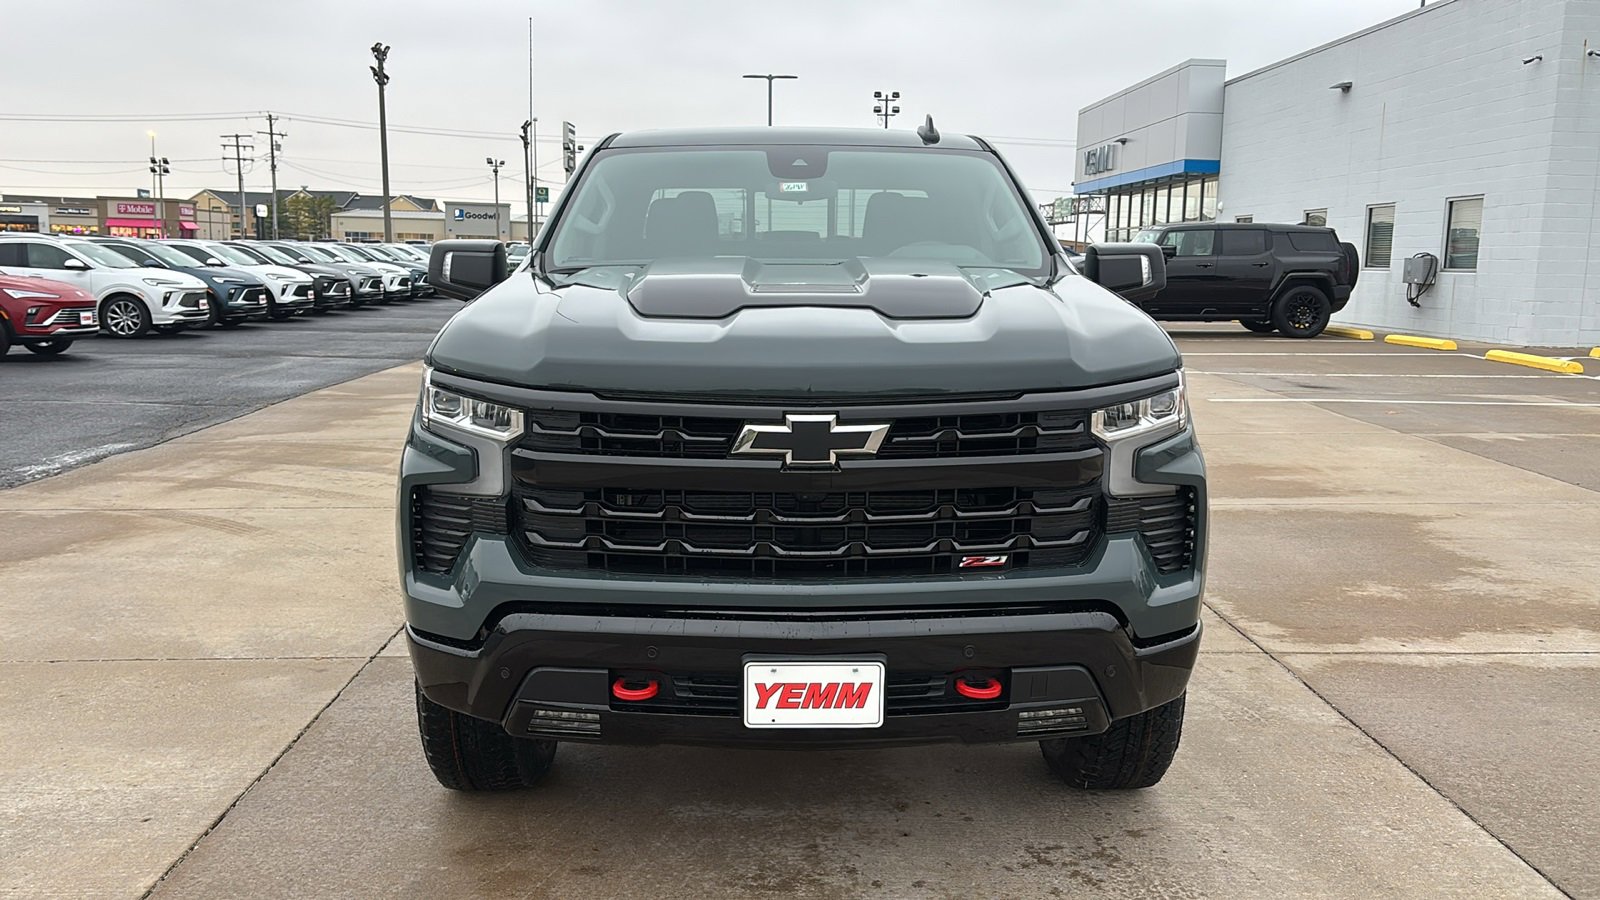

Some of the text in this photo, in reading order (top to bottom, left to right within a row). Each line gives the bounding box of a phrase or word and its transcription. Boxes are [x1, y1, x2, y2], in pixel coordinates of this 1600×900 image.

[465, 211, 500, 220] Goodwi
[959, 556, 1008, 567] Z71
[754, 682, 873, 709] YEMM
